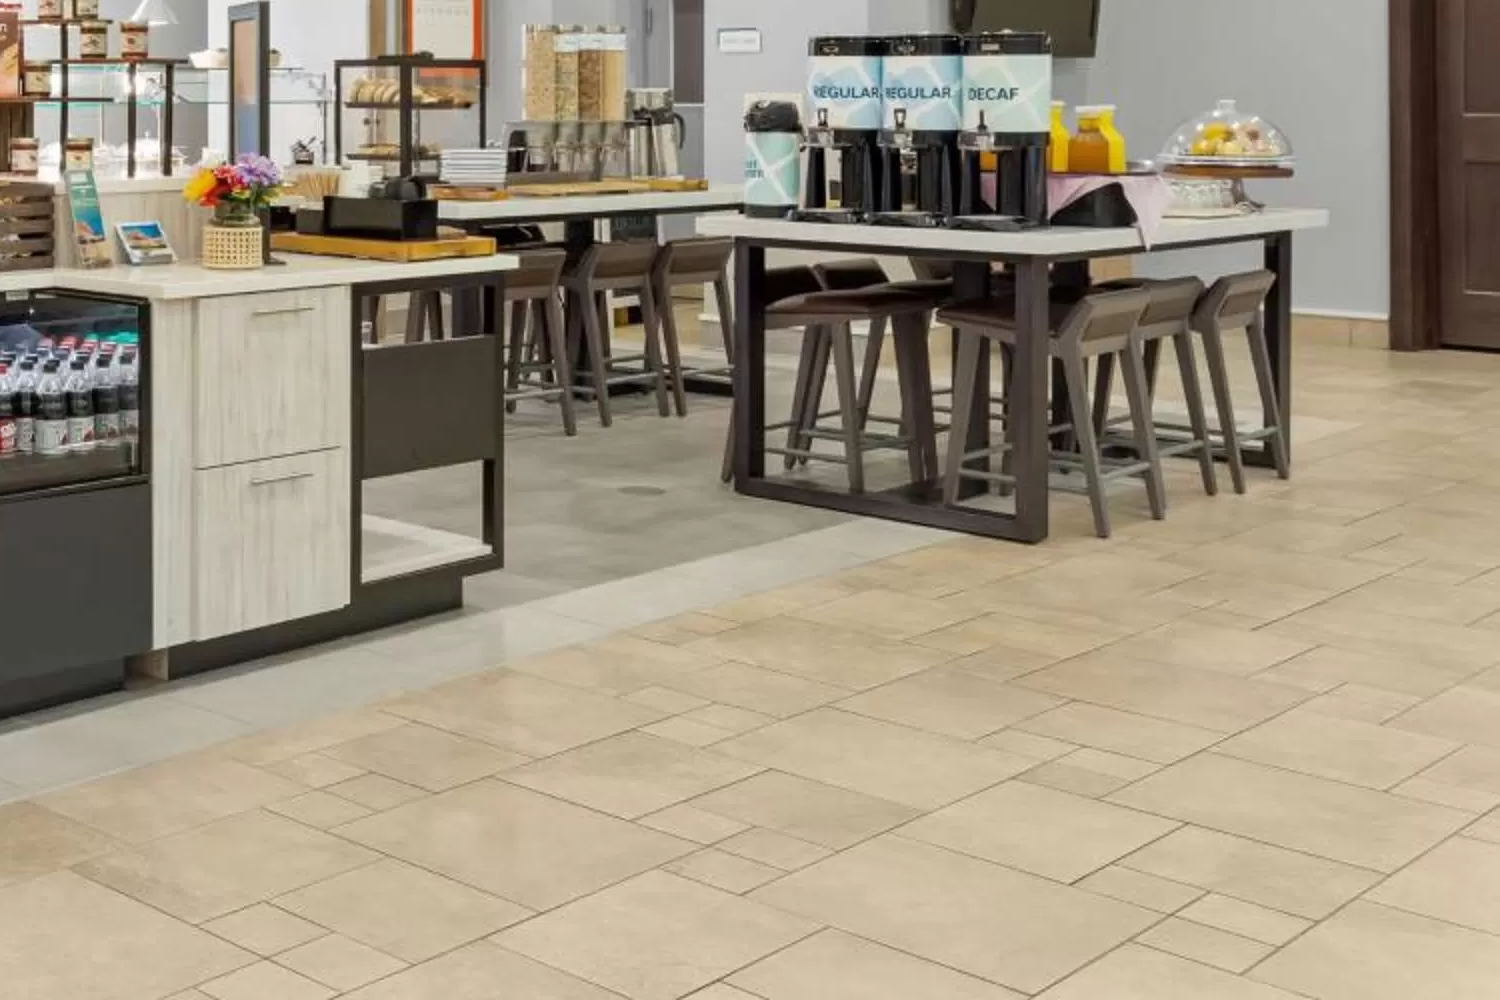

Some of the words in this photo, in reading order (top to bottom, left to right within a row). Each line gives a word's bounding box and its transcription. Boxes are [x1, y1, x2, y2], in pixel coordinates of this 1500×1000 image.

[813, 85, 880, 100] REGULAR
[884, 85, 951, 99] REGULAR
[967, 87, 1020, 101] DECAF
